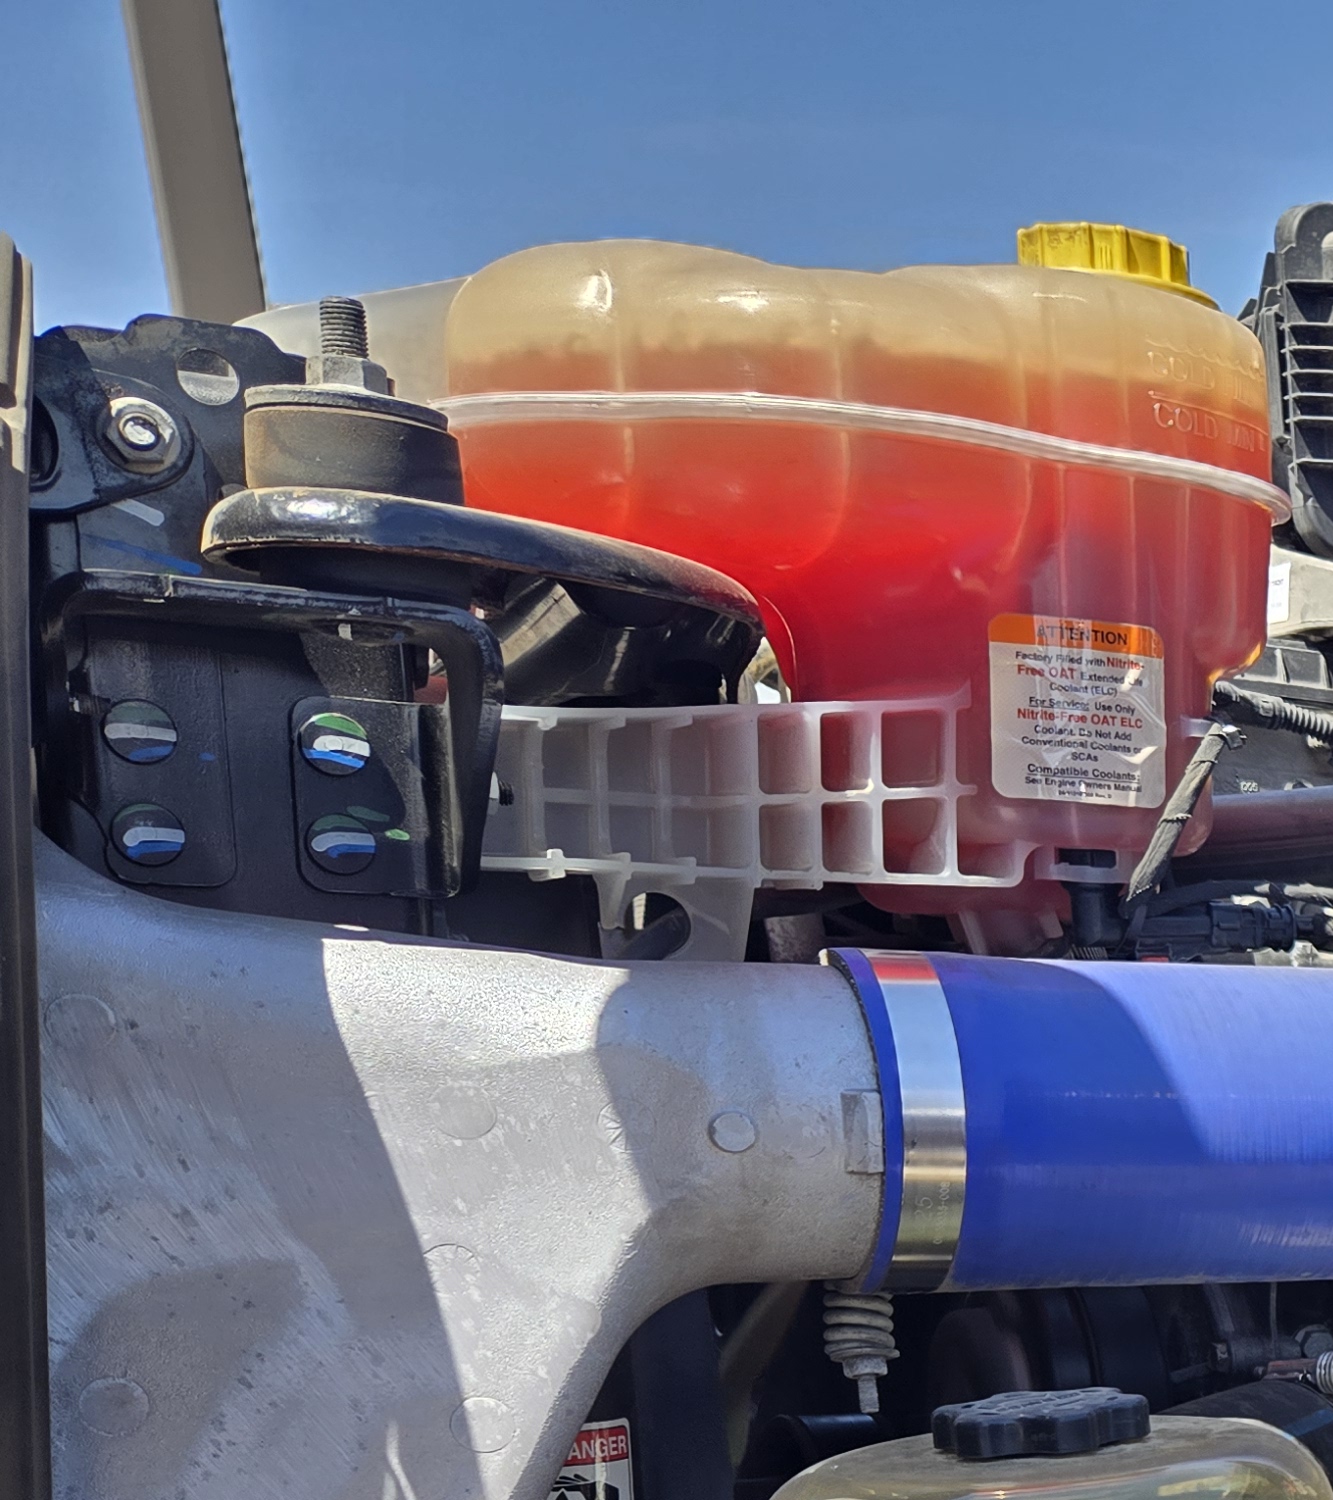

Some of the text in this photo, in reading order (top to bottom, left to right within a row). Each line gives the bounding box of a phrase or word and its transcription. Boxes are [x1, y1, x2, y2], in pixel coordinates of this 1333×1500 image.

[1036, 624, 1128, 646] ATTENTION
[1016, 651, 1145, 671] Factory Filled with Nitrite-
[1017, 664, 1125, 685] Free OAT Extended
[1050, 683, 1118, 698] Coolant (ELC)
[1029, 697, 1136, 716] For Service: Use Only
[1017, 708, 1143, 729] Nitrite-Free OAT ELC
[1095, 730, 1112, 740] Not
[1114, 731, 1132, 741] Add
[1021, 736, 1131, 755] Conventional Coolants
[1071, 752, 1099, 762] SCAs
[1027, 763, 1140, 782] Compatible Coolants:
[1025, 776, 1043, 786] See
[1044, 778, 1077, 790] Engine
[1114, 784, 1142, 793] Manual
[568, 1433, 628, 1461] ANGER
